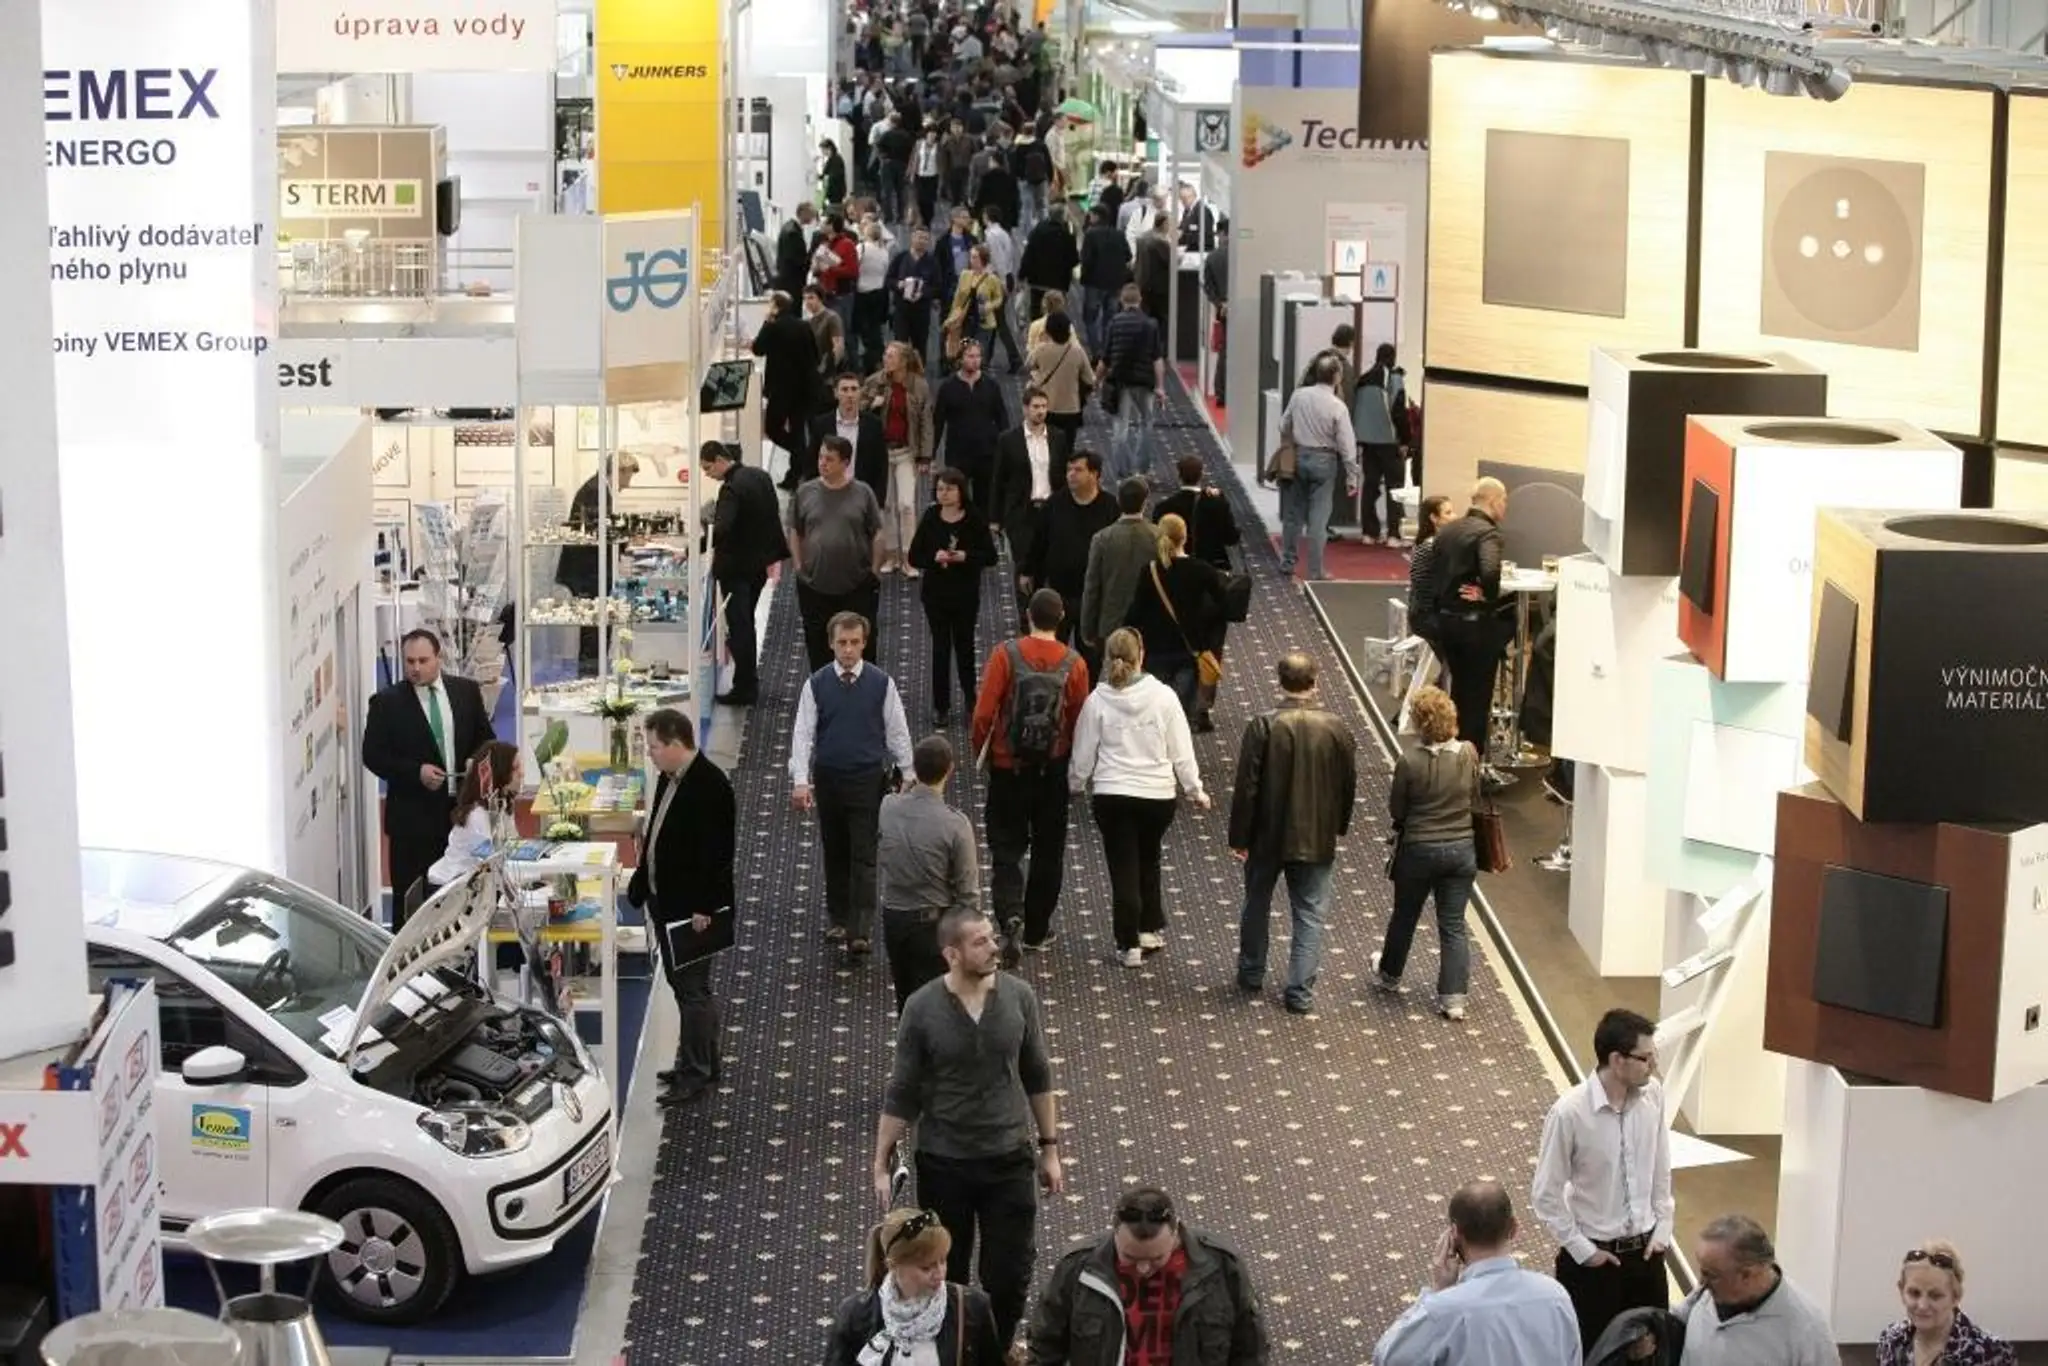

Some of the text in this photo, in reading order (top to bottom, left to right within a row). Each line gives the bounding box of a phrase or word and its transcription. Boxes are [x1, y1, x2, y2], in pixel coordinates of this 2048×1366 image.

[334, 12, 526, 41] úprava vody
[628, 64, 708, 79] JUNKERS
[138, 223, 264, 247] dodávateľ
[50, 256, 187, 285] ného plynu
[104, 331, 189, 352] VEMEX
[195, 331, 268, 357] Group
[278, 357, 333, 388] est
[1941, 665, 2048, 688] VÝNIMOČN
[1945, 689, 2048, 710] MATERIÁL
